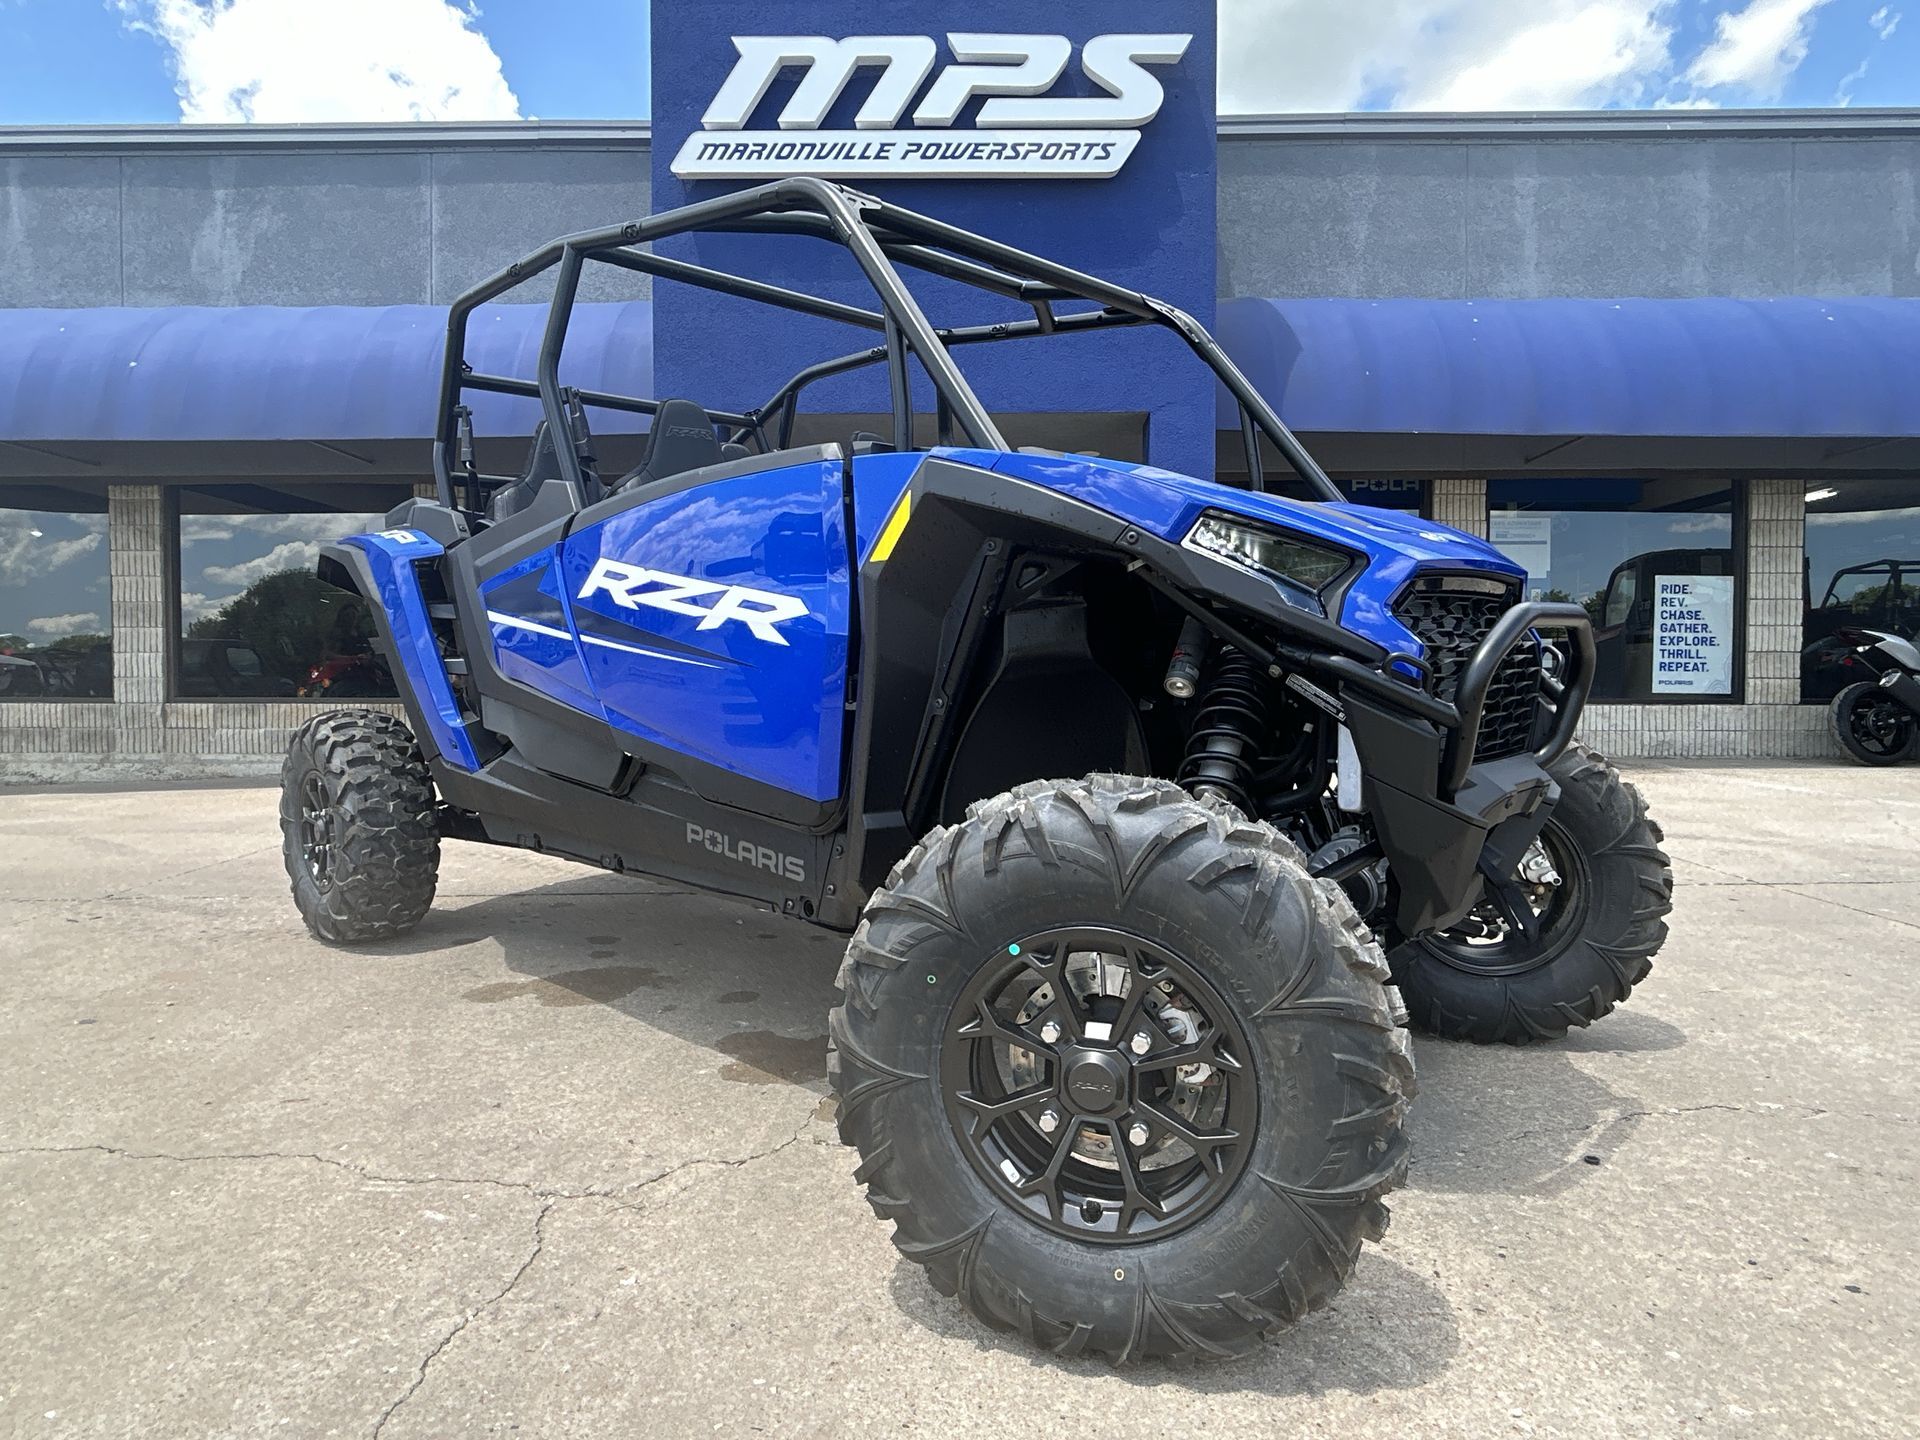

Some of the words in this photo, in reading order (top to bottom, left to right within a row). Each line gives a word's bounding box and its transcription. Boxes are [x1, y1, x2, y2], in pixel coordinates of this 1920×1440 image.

[700, 33, 1194, 129] MPS
[696, 142, 896, 161] MARIONVILLE
[901, 142, 1117, 161] POWERSPORTS
[1661, 584, 1693, 594] RIDE.
[576, 556, 811, 647] RZR
[1661, 597, 1688, 607] REV.
[1660, 610, 1705, 620] CHASE.
[1660, 623, 1712, 633] GATHER.
[1659, 636, 1720, 646] EXPLORE.
[1659, 649, 1706, 659] THRILL.
[1659, 662, 1709, 672] REPEAT.
[686, 822, 805, 882] POLARIS
